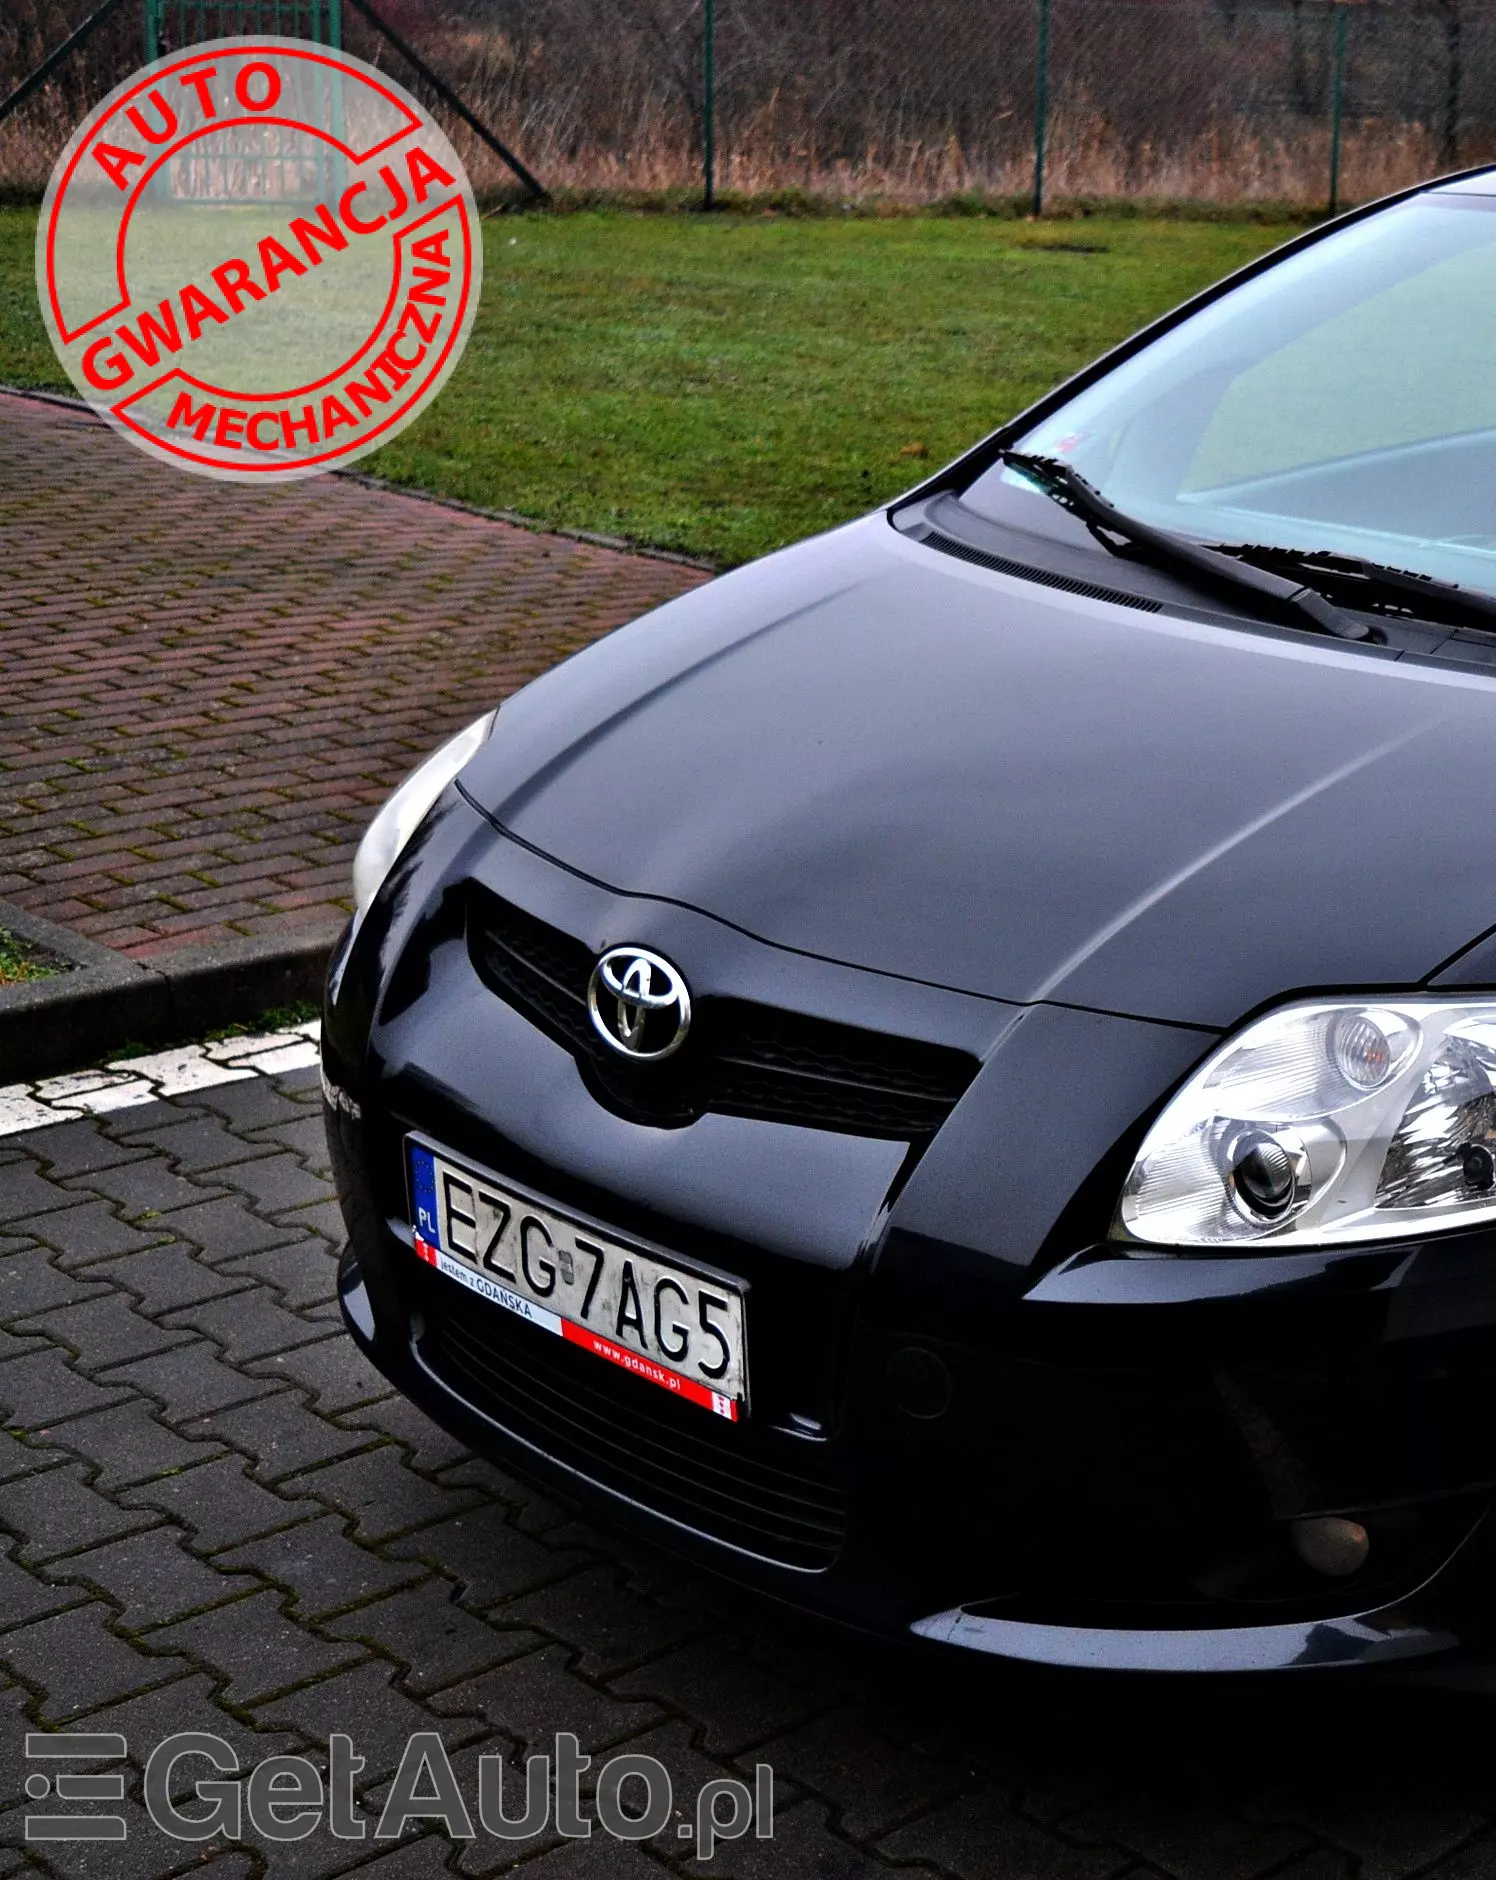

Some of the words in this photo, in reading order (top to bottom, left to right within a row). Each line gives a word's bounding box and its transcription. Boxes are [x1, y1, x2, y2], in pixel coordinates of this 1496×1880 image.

[418, 1207, 436, 1234] PL
[443, 1171, 557, 1298] EZG
[575, 1235, 732, 1380] 7AG5
[593, 1339, 681, 1391] www.gdansk.pl
